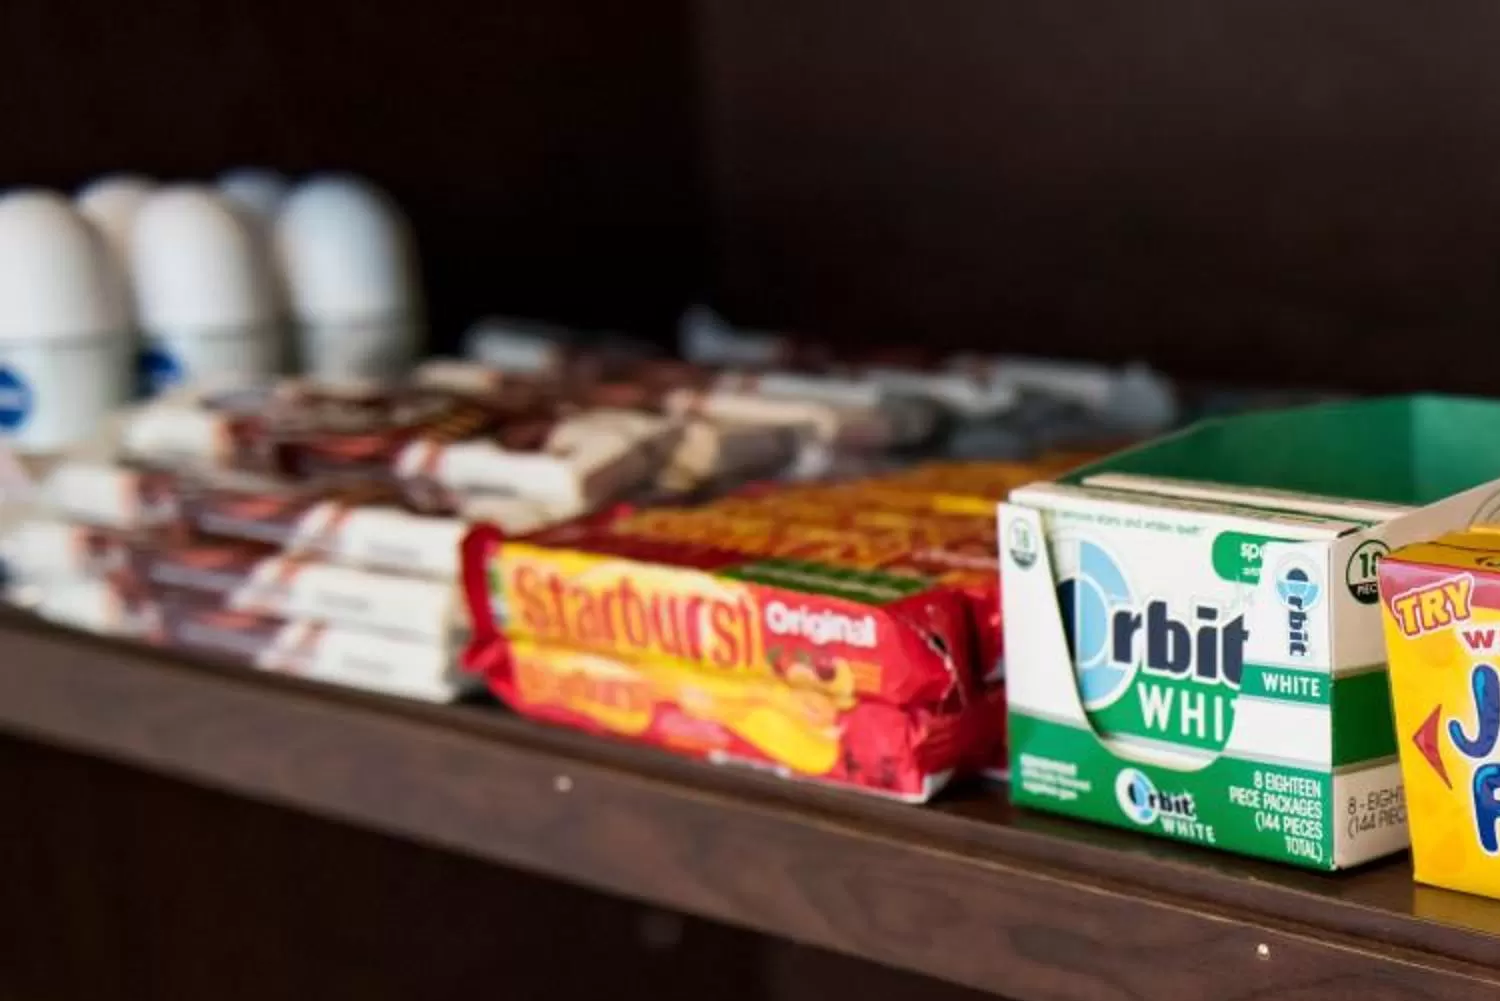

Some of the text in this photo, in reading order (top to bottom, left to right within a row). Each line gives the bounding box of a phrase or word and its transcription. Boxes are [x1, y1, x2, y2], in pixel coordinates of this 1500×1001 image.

[1394, 578, 1471, 636] TRY
[765, 601, 878, 648] Original
[1262, 672, 1321, 697] WHITE
[1137, 682, 1238, 741] WHI
[1253, 770, 1321, 798] 8 EIGHTEEN
[1228, 786, 1323, 819] PIECE PACKAGES
[1160, 817, 1216, 843] WHITE
[1255, 811, 1323, 841] (144 PIECES
[1285, 836, 1323, 863] TOTAL)
